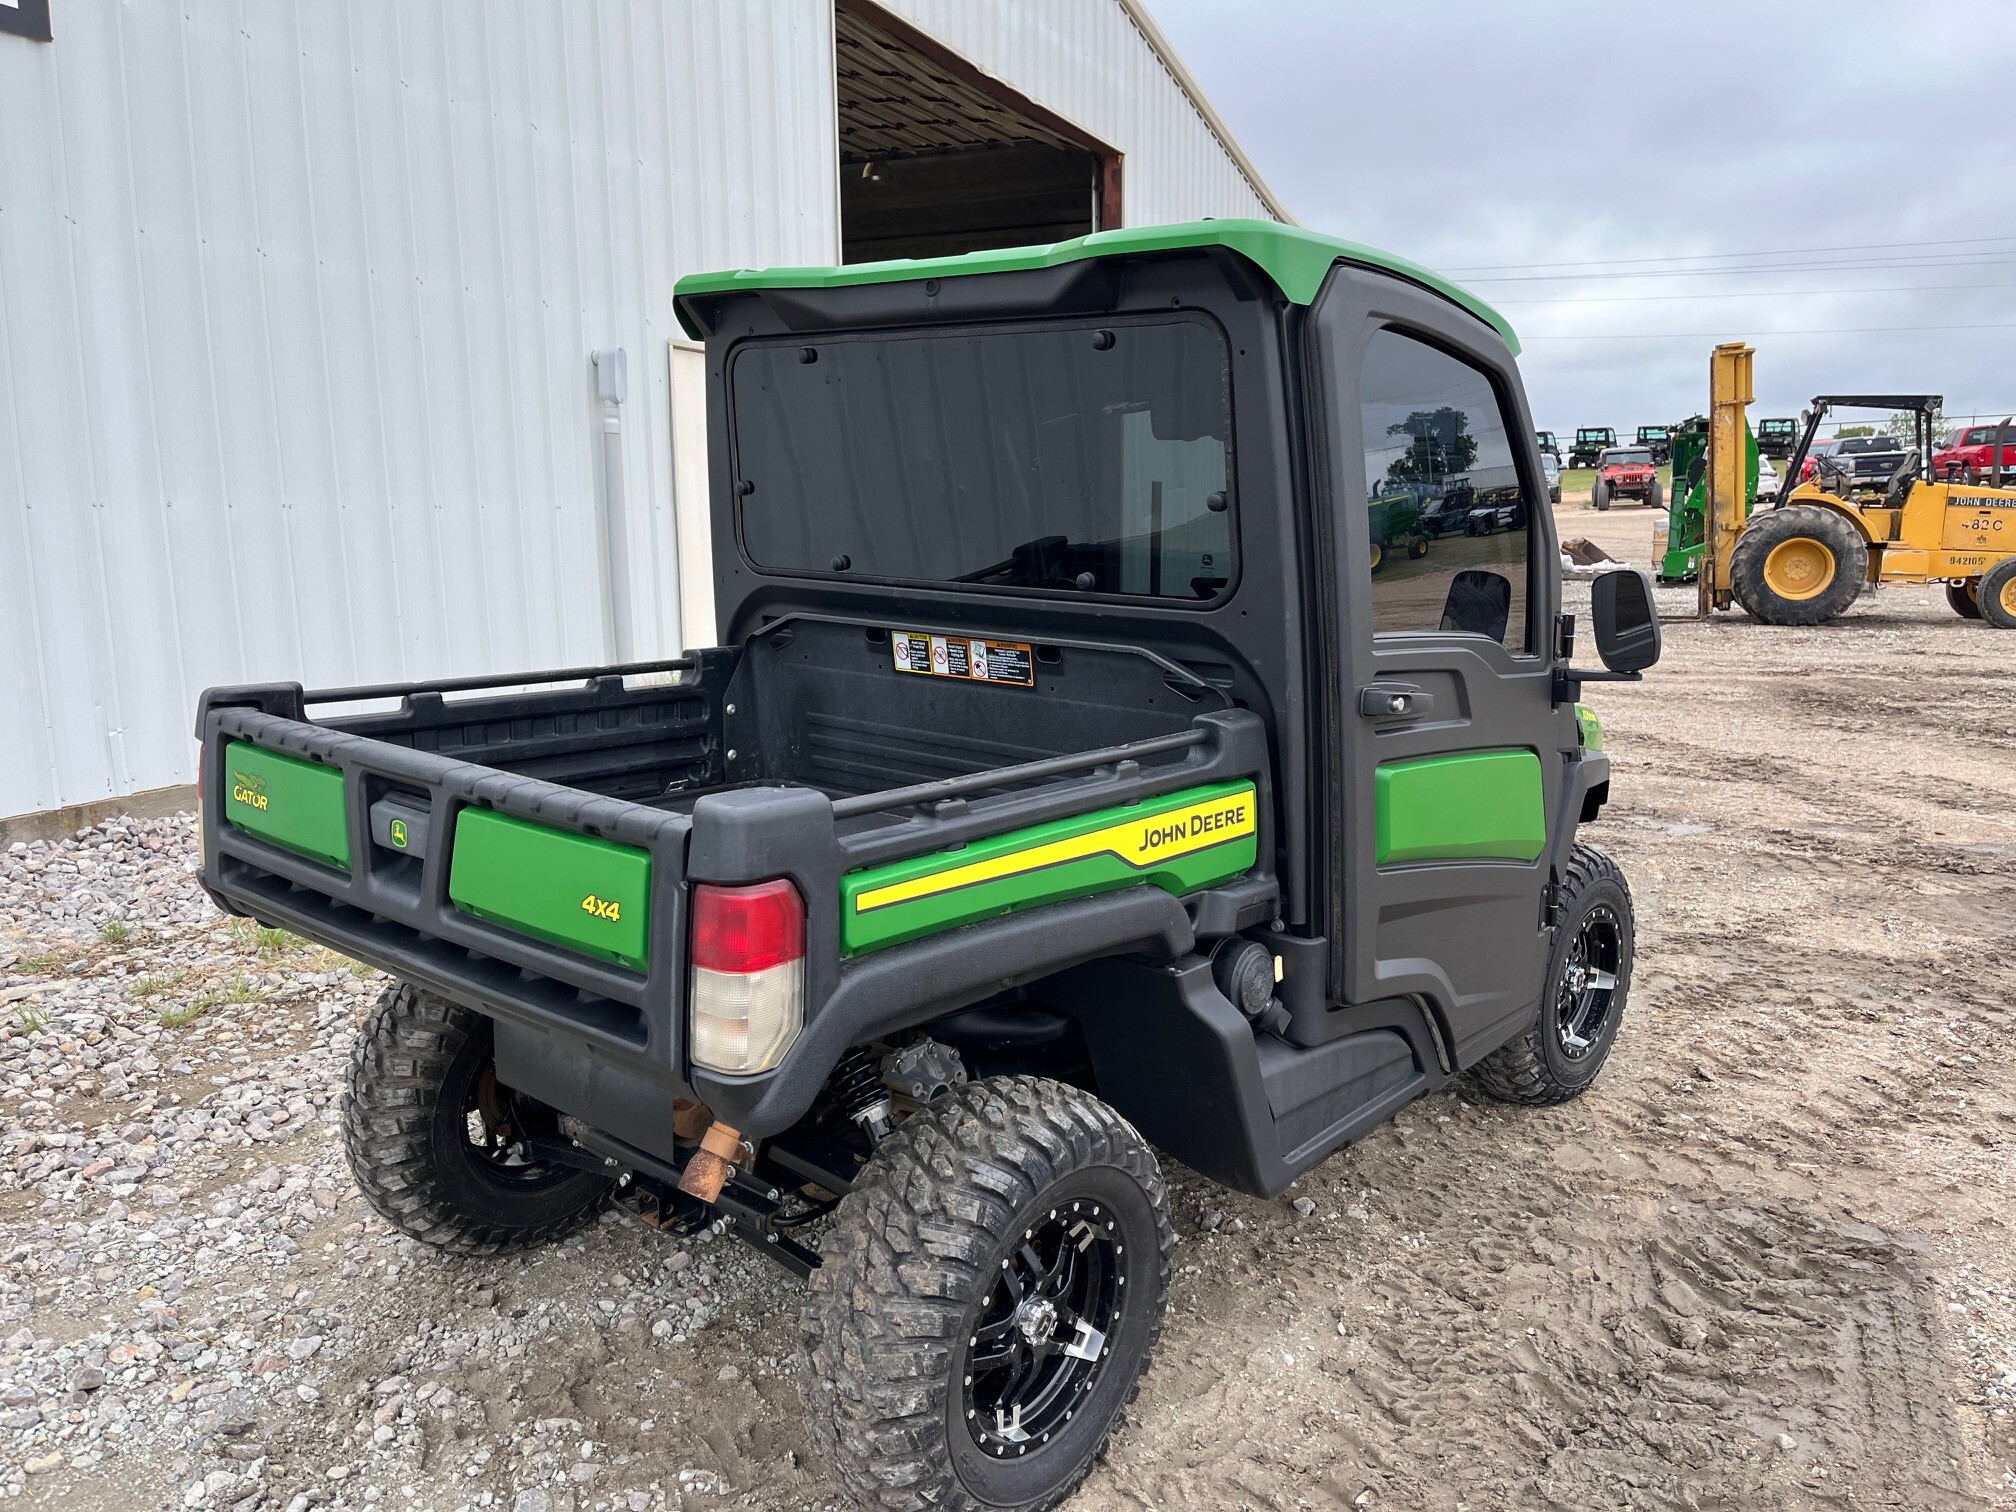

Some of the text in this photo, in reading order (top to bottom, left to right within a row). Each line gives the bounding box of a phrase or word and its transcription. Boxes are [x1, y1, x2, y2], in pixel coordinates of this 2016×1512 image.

[1954, 497, 2016, 508] JOHN DEERE
[233, 784, 268, 811] GATOR
[1139, 806, 1245, 852] JOHN DEERE
